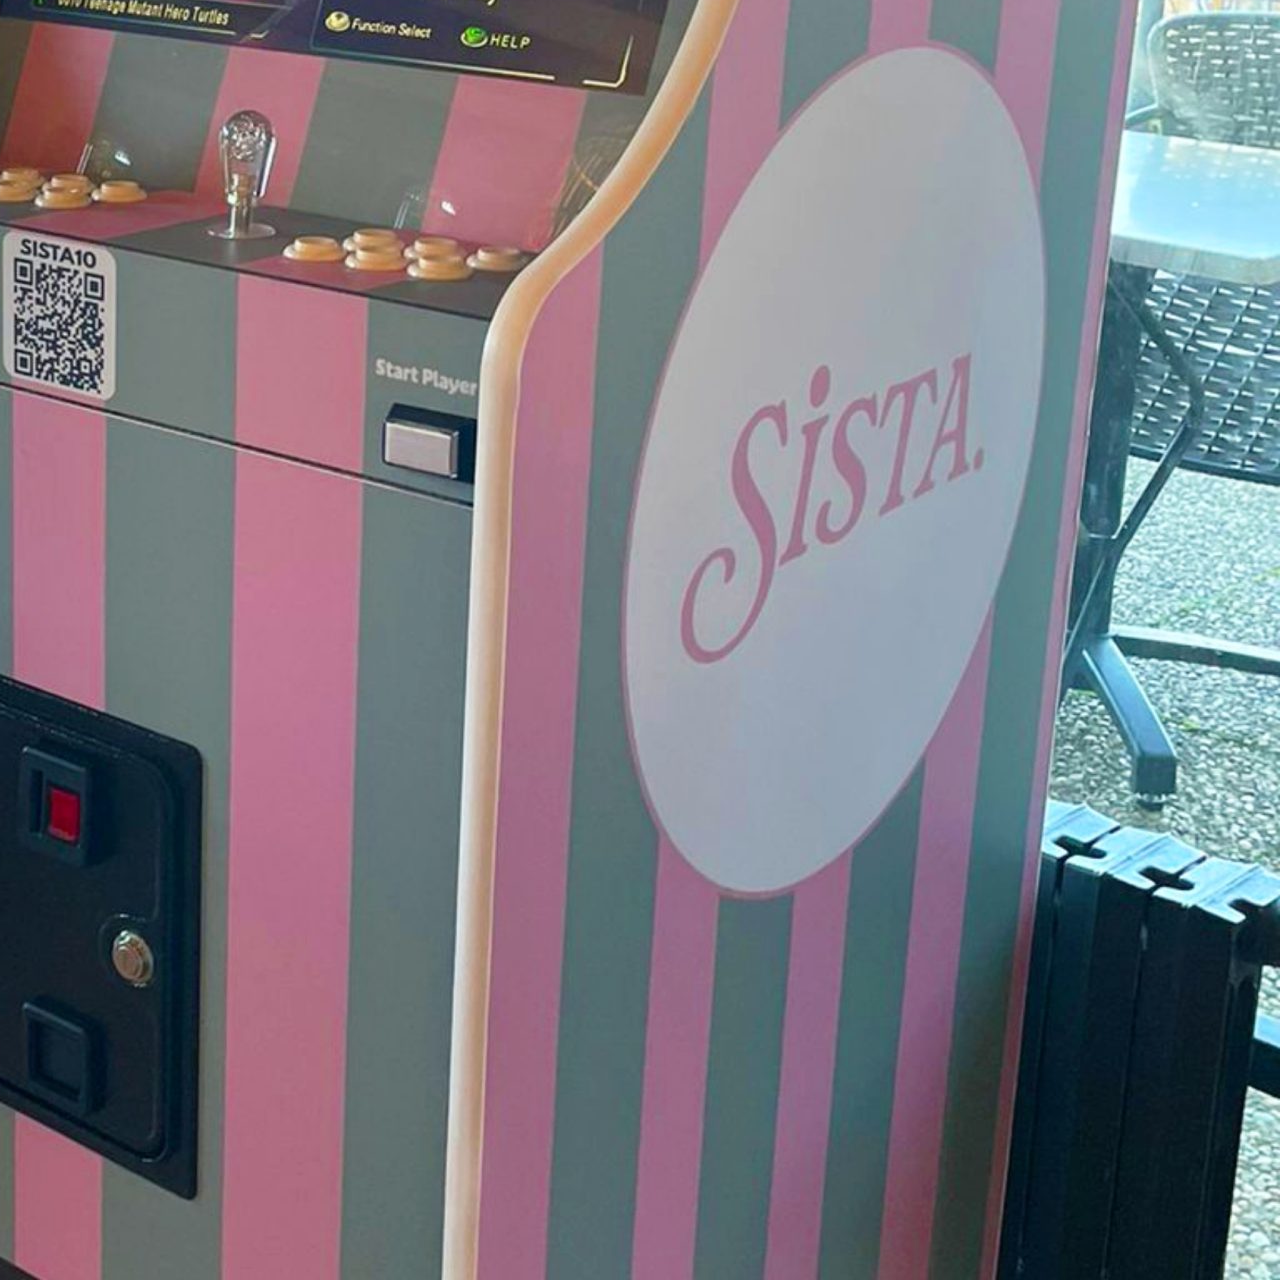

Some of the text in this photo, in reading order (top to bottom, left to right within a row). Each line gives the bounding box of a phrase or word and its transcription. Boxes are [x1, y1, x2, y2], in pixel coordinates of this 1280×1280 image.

[164, 1, 190, 20] Hero
[191, 6, 230, 26] Turtles
[351, 18, 433, 39] Function Select
[489, 33, 532, 50] HELP
[20, 238, 97, 270] SISTA10
[375, 357, 478, 397] Start Player
